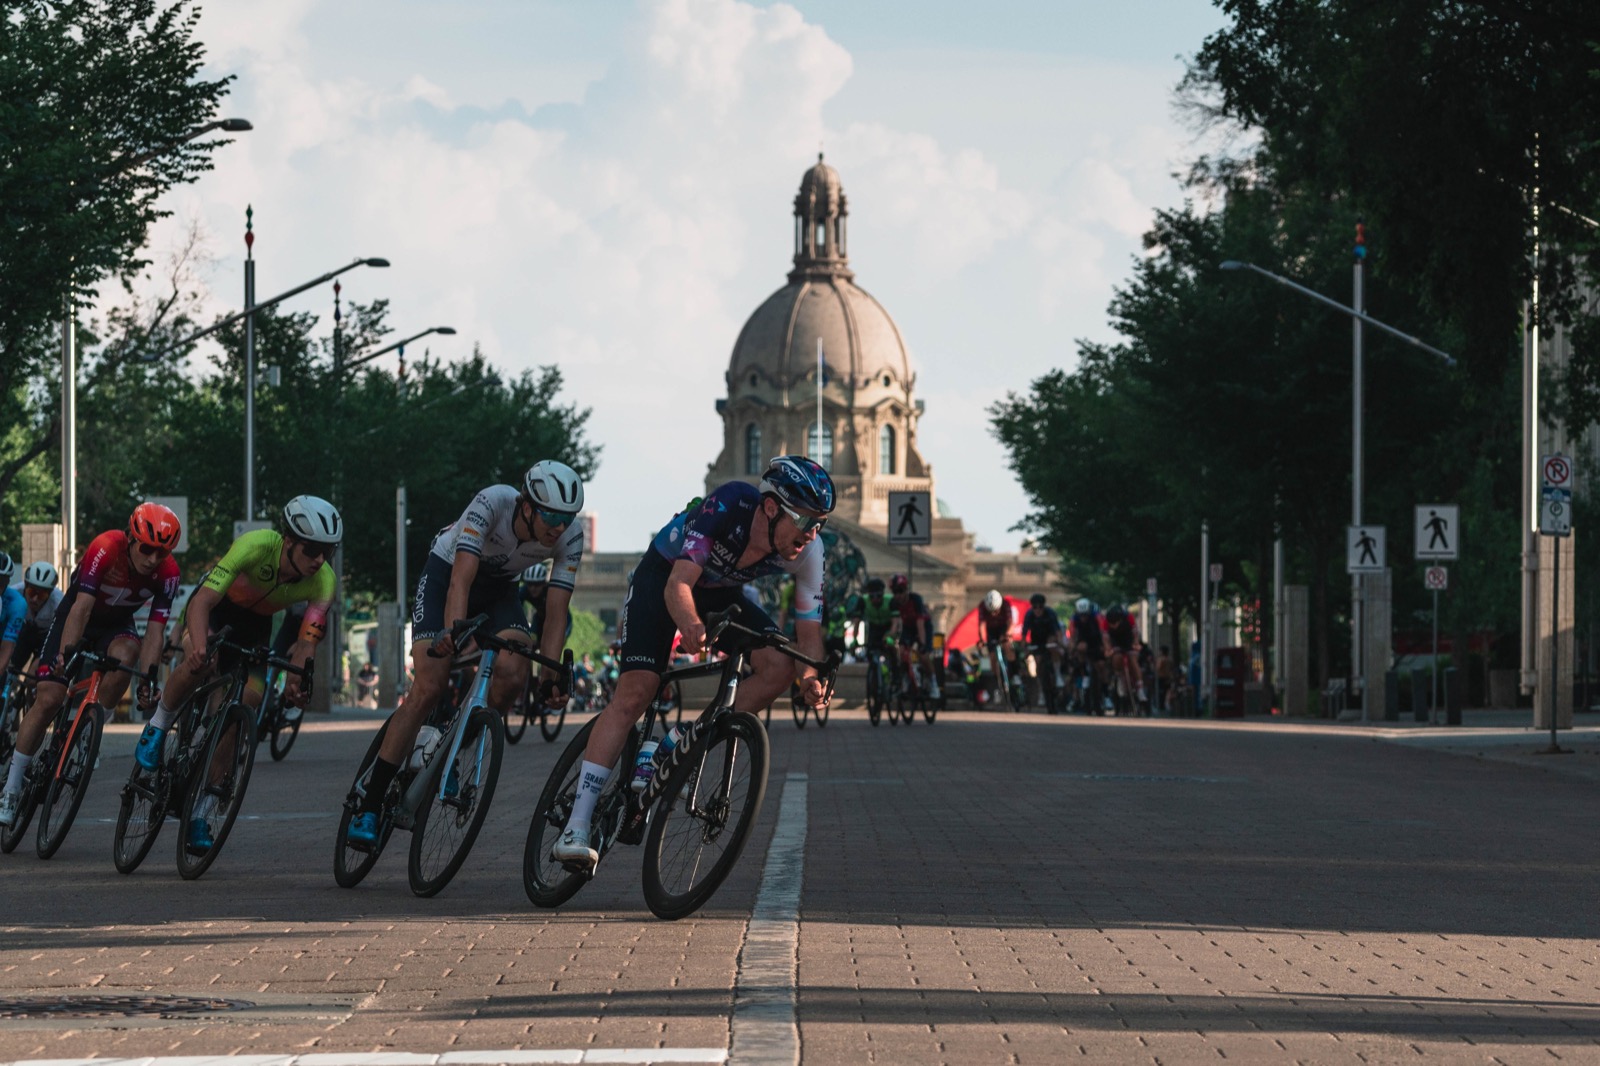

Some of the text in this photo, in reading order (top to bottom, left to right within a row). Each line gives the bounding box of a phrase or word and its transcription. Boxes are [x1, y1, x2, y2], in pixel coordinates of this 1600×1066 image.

[88, 547, 106, 577] THORNE
[414, 574, 428, 623] TORONTO
[626, 655, 655, 664] COGEAS
[585, 772, 605, 786] ISRAEL
